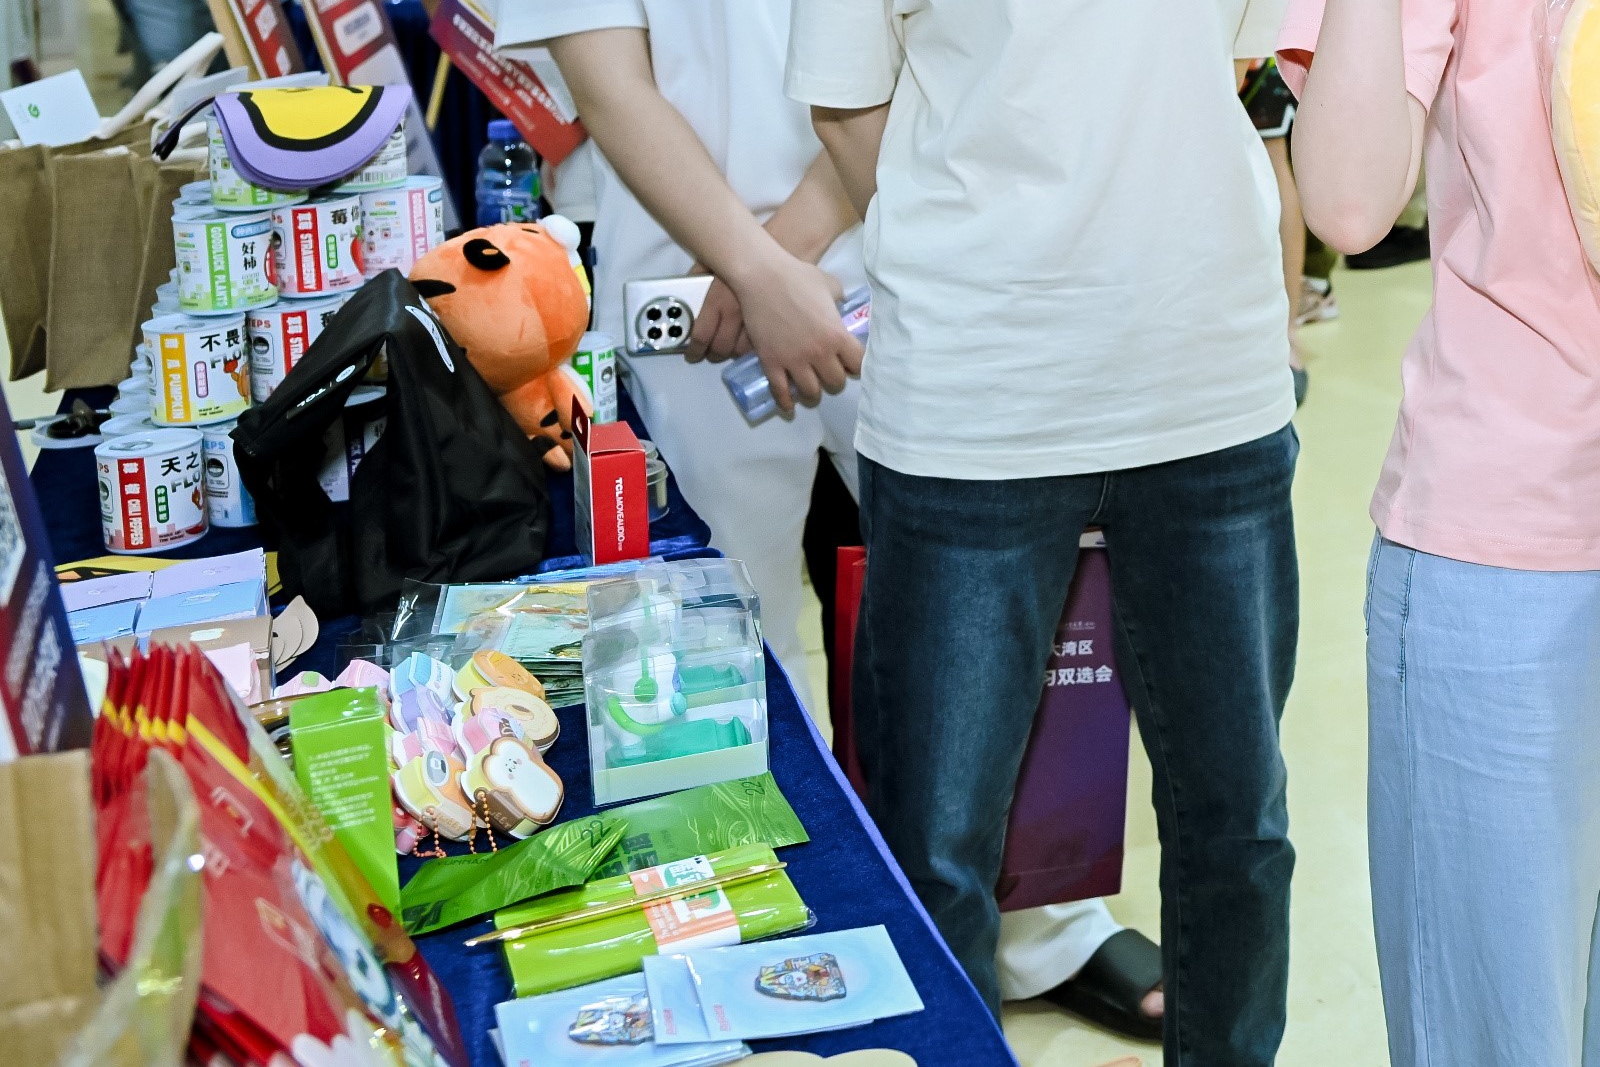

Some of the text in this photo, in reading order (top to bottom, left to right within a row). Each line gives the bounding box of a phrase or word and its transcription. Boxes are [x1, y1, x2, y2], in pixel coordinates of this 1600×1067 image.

[210, 226, 225, 272] GOODLUCK
[301, 232, 317, 290] STRAWBERRY
[169, 374, 185, 420] PUMPKIN
[161, 451, 200, 477] 天之
[129, 516, 144, 546] PEPPERS
